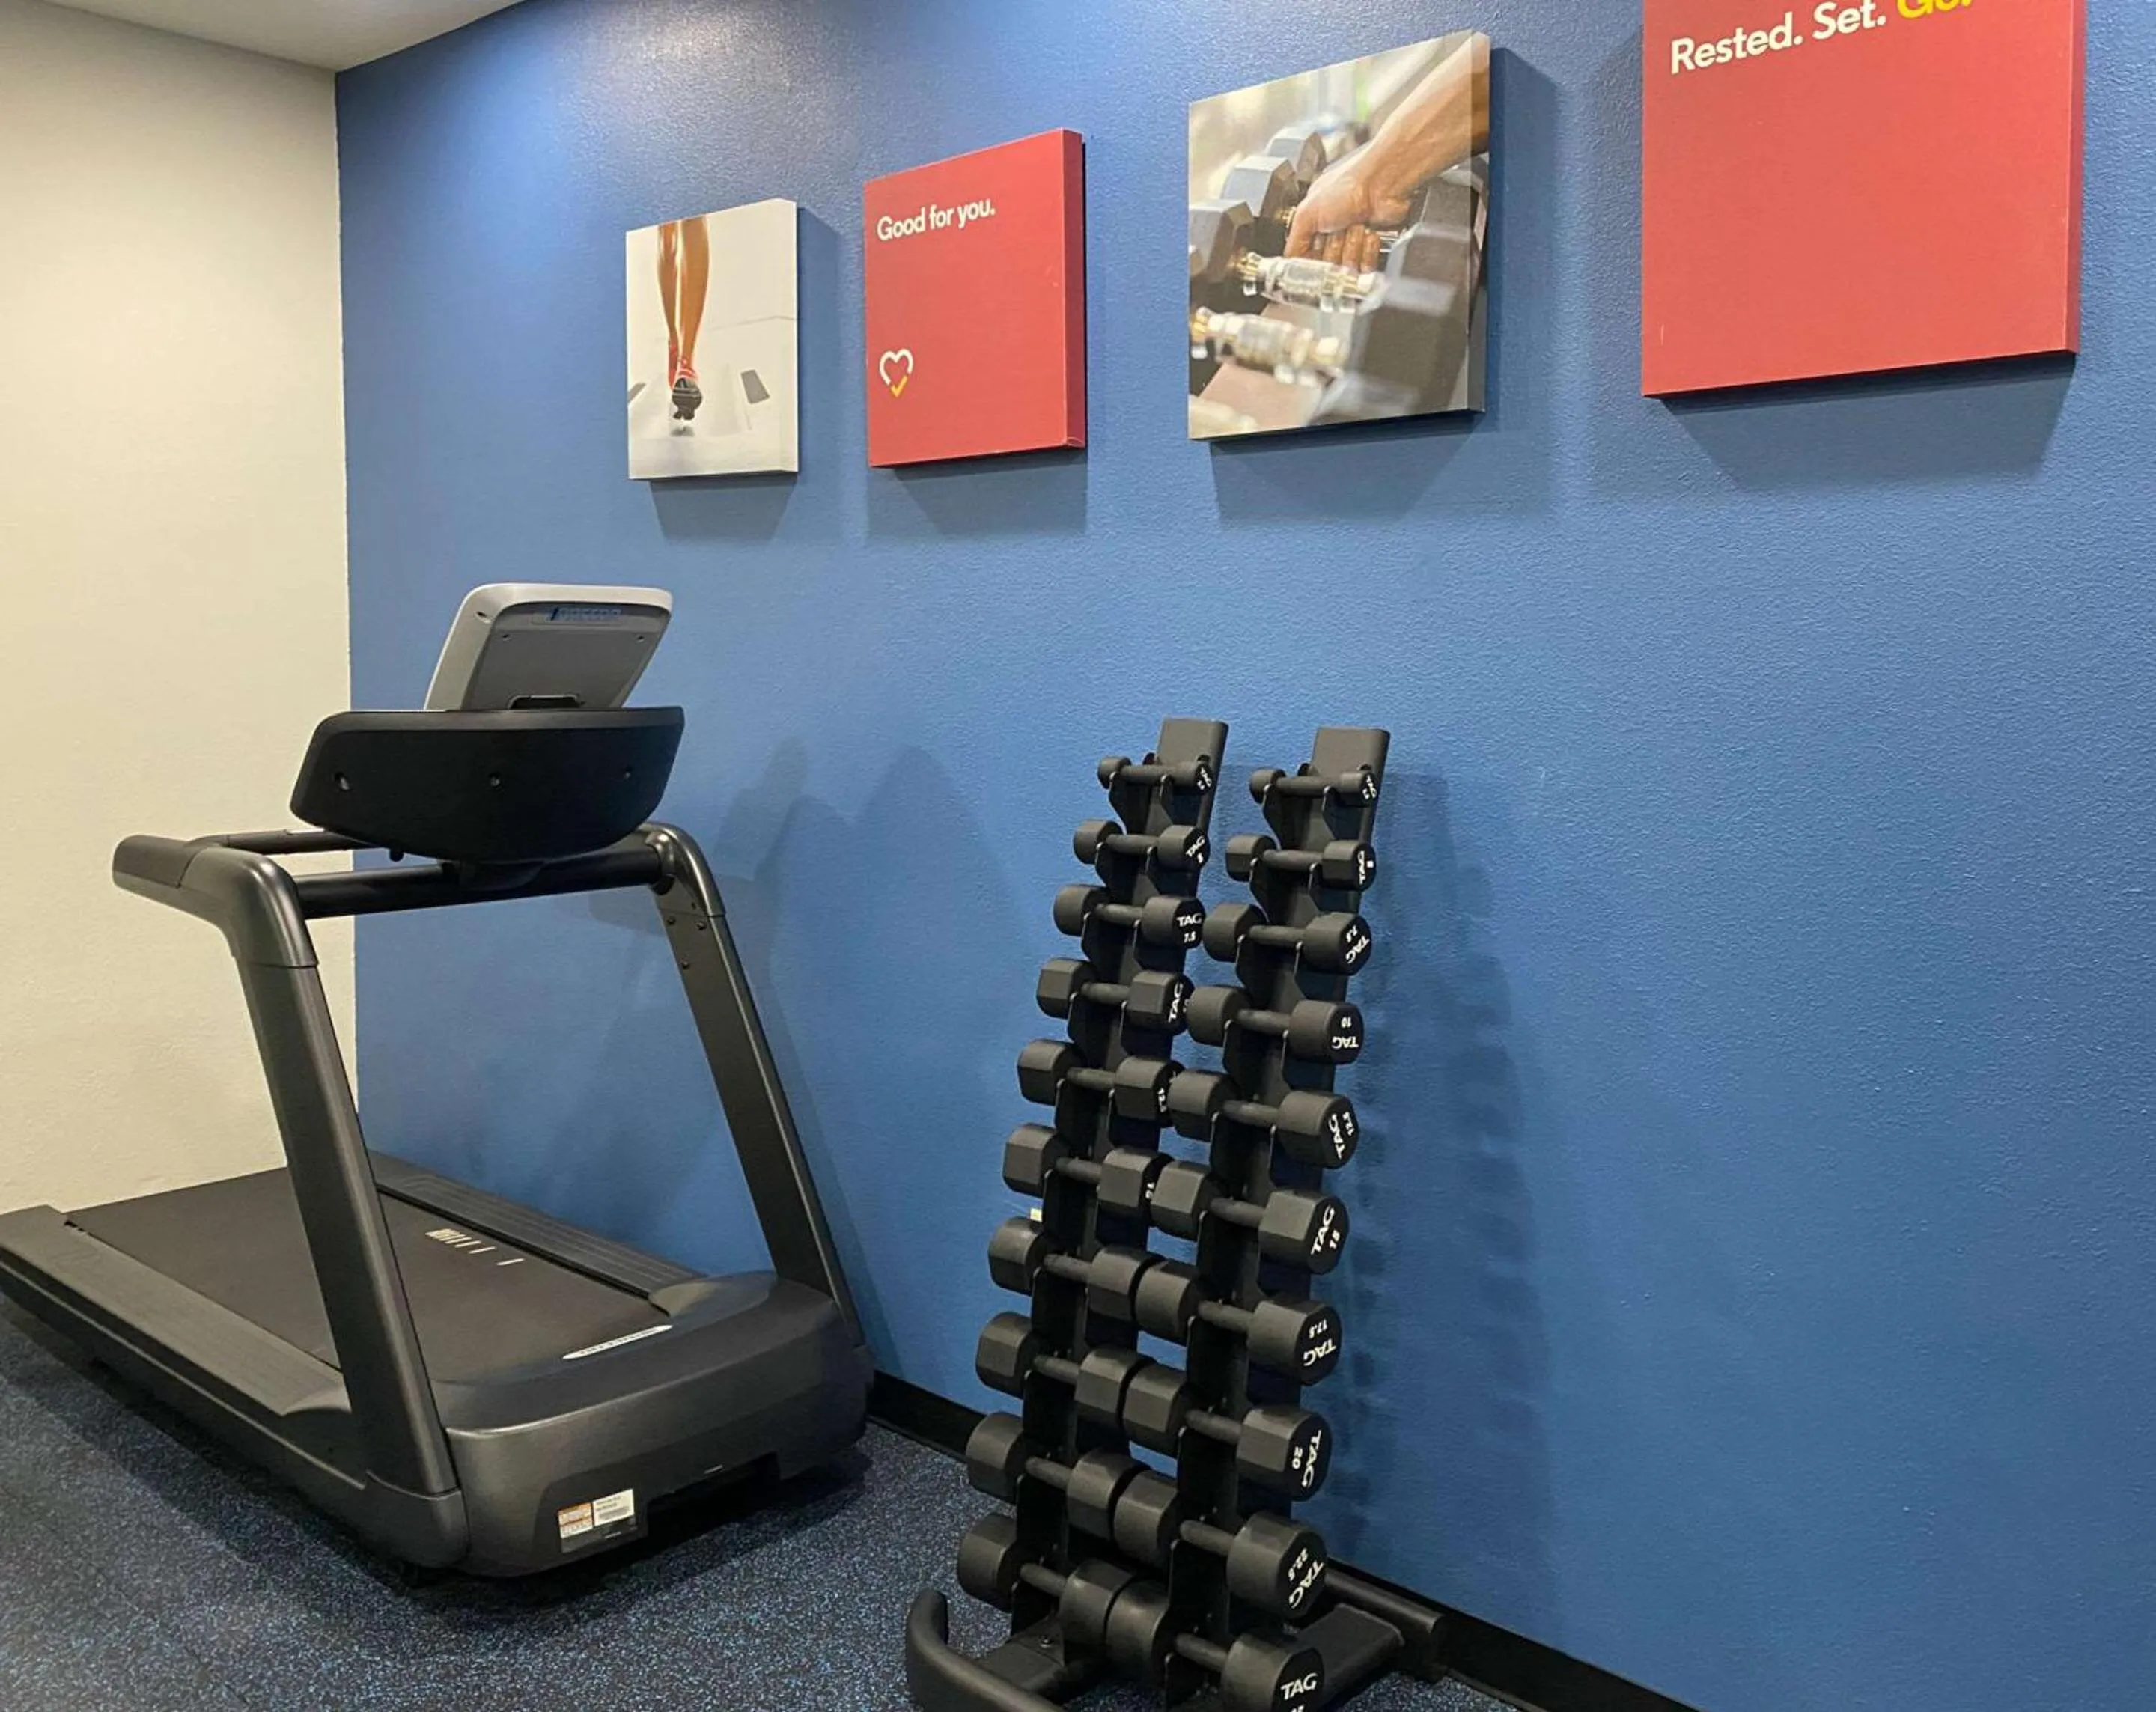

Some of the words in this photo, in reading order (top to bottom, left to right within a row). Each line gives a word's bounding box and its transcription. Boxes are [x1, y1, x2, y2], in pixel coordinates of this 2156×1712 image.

[1670, 12, 1803, 74] Rested.
[1812, 0, 1886, 40] Set.
[877, 207, 925, 241] Good
[929, 204, 954, 229] for
[957, 198, 996, 229] you.
[1185, 835, 1205, 857] TAG
[1357, 850, 1365, 885] TAG
[1175, 913, 1202, 927] TAG
[1345, 935, 1370, 964] TAG
[1168, 982, 1184, 1023] TAG
[1332, 1036, 1359, 1050] TAG
[1328, 1113, 1345, 1160] TAG
[1310, 1204, 1335, 1255] TAG
[1303, 1338, 1336, 1367] TAG
[1292, 1446, 1303, 1469] 20
[1302, 1429, 1321, 1488] TAG
[1289, 1560, 1324, 1609] TAG
[1280, 1672, 1318, 1700] TAG
